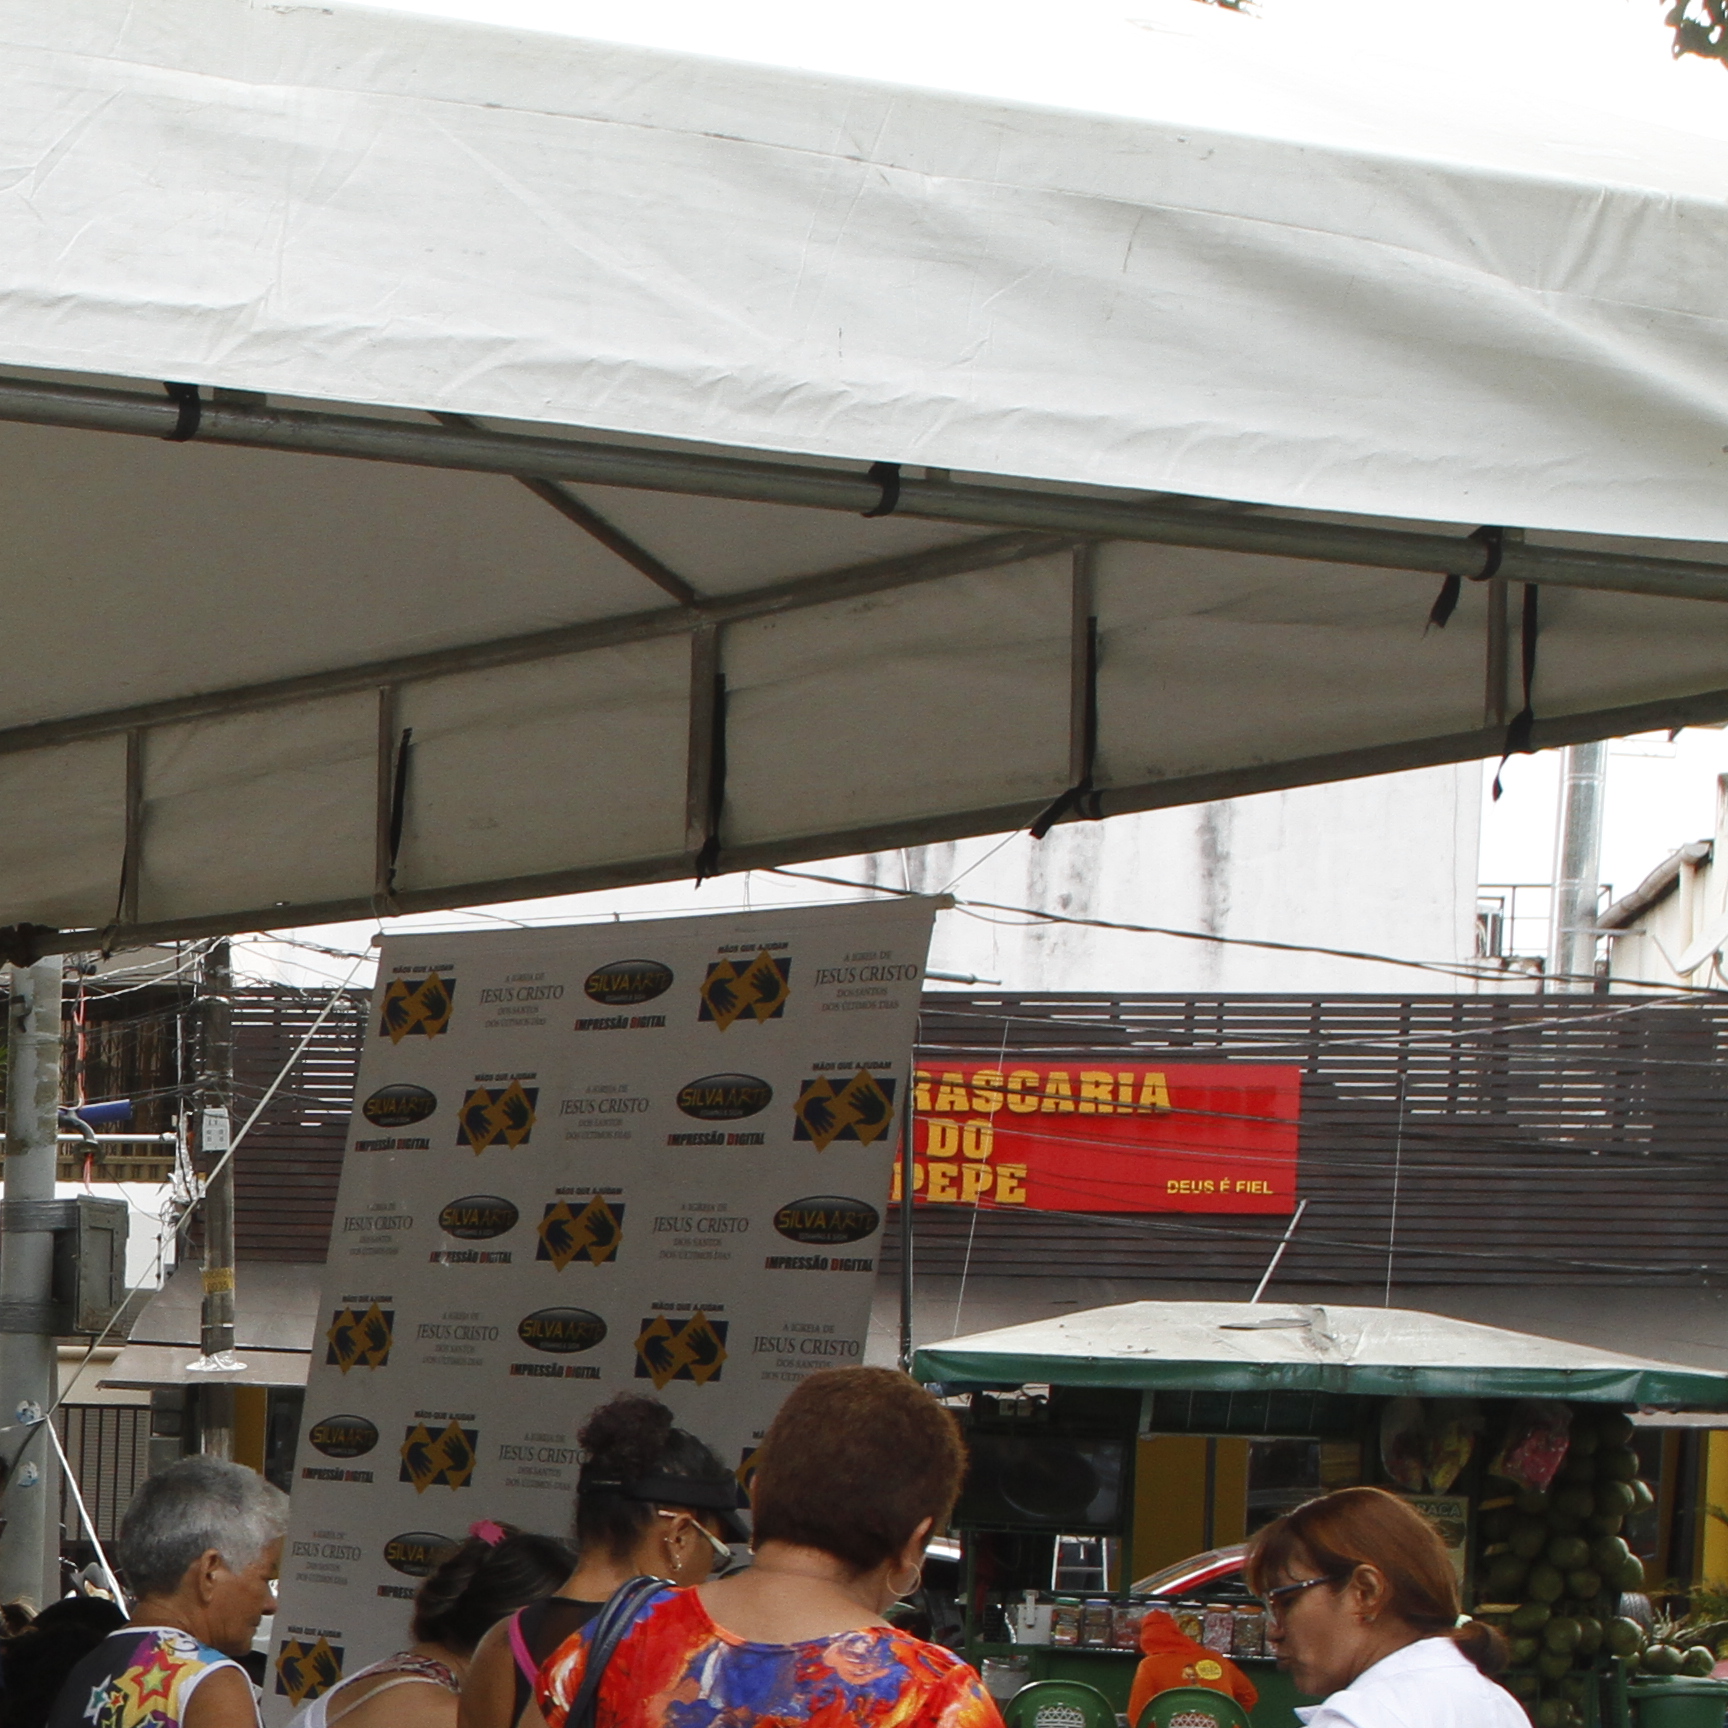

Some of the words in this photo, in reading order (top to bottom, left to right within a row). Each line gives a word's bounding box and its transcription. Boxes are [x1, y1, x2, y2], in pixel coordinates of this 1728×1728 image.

[588, 975, 630, 992] SILVA
[814, 968, 855, 987] JESUS
[860, 964, 918, 981] CRISTO
[481, 988, 513, 1004] JESUS
[516, 985, 564, 1000] CRISTO
[574, 1015, 629, 1031] IMPRESSÃO
[630, 1015, 666, 1029] DIGITAL
[680, 1088, 722, 1106] SILVA
[559, 1100, 595, 1116] JESUS
[598, 1098, 649, 1114] CRISTO
[667, 1131, 724, 1146] IMPRESSÃO
[726, 1133, 765, 1146] DIGITAL
[926, 1117, 994, 1159] DO
[893, 1163, 1028, 1203] PEPE
[1167, 1179, 1214, 1195] DEUS
[1220, 1177, 1231, 1194] É
[1235, 1179, 1273, 1195] FIEL
[344, 1216, 372, 1231] JESUS
[374, 1215, 413, 1230] CRISTO
[442, 1209, 478, 1225] SILVA
[653, 1216, 692, 1234] JESUS
[697, 1216, 749, 1233] CRISTO
[778, 1210, 826, 1229] SILVA
[765, 1255, 828, 1270] IMPRESSÃO
[831, 1258, 873, 1272] DIGITAL
[417, 1324, 450, 1340] JESUS
[454, 1325, 499, 1341] CRISTO
[520, 1320, 562, 1337] SILVA
[752, 1336, 796, 1354] JESUS
[800, 1338, 860, 1357] CRISTO
[510, 1362, 564, 1378] IMPRESSÃO
[565, 1364, 601, 1379] DIGITAL
[291, 1541, 320, 1558] JESUS
[321, 1543, 362, 1561] CRISTO
